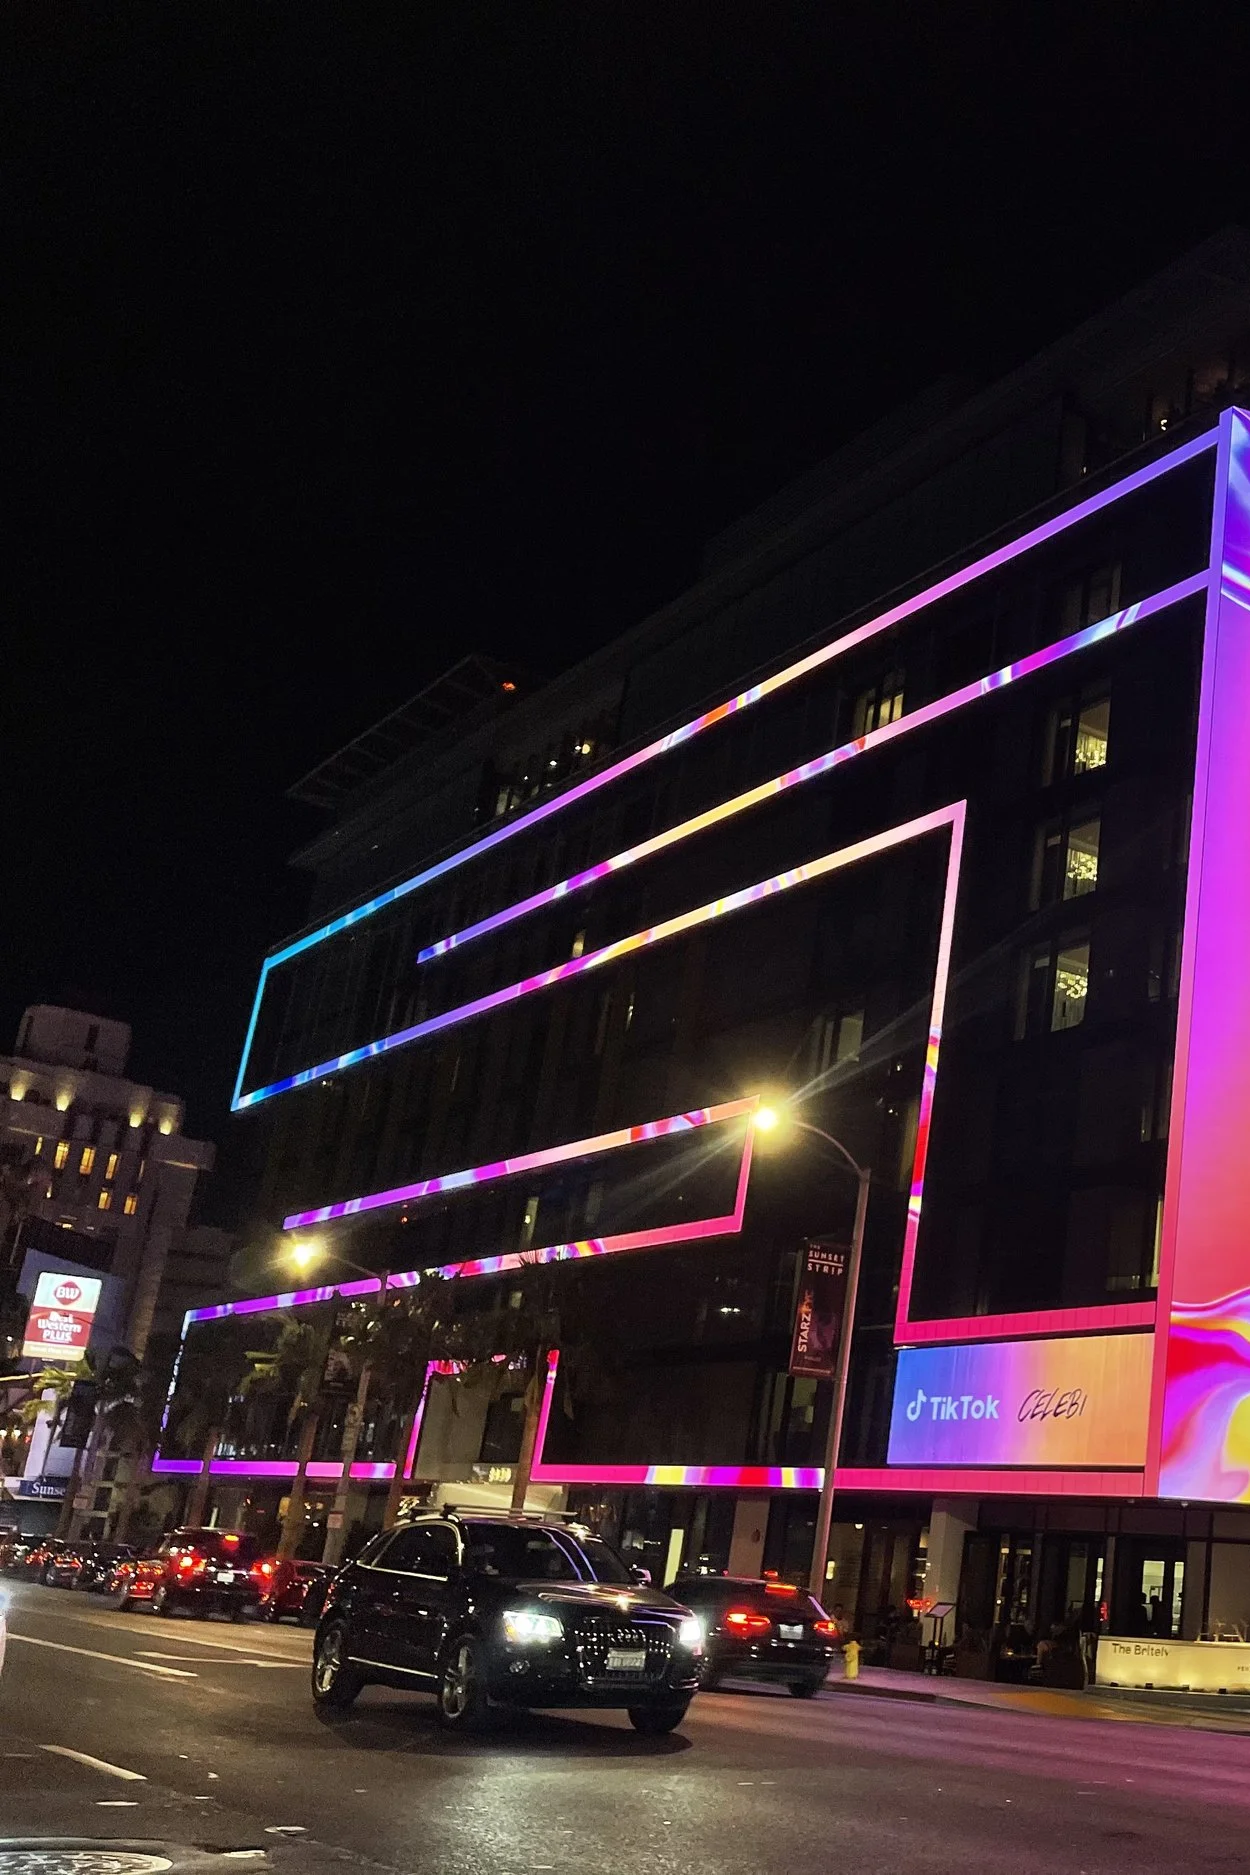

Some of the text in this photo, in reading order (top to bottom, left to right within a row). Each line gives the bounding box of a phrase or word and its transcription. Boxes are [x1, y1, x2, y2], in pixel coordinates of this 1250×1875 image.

[808, 1250, 844, 1263] SUNSET
[807, 1262, 843, 1275] STRIP
[56, 1286, 80, 1300] BW
[37, 1318, 83, 1333] Western
[42, 1330, 72, 1343] PLUS
[930, 1394, 1000, 1421] TikTok
[31, 1481, 67, 1497] Sunse
[1112, 1642, 1131, 1655] The
